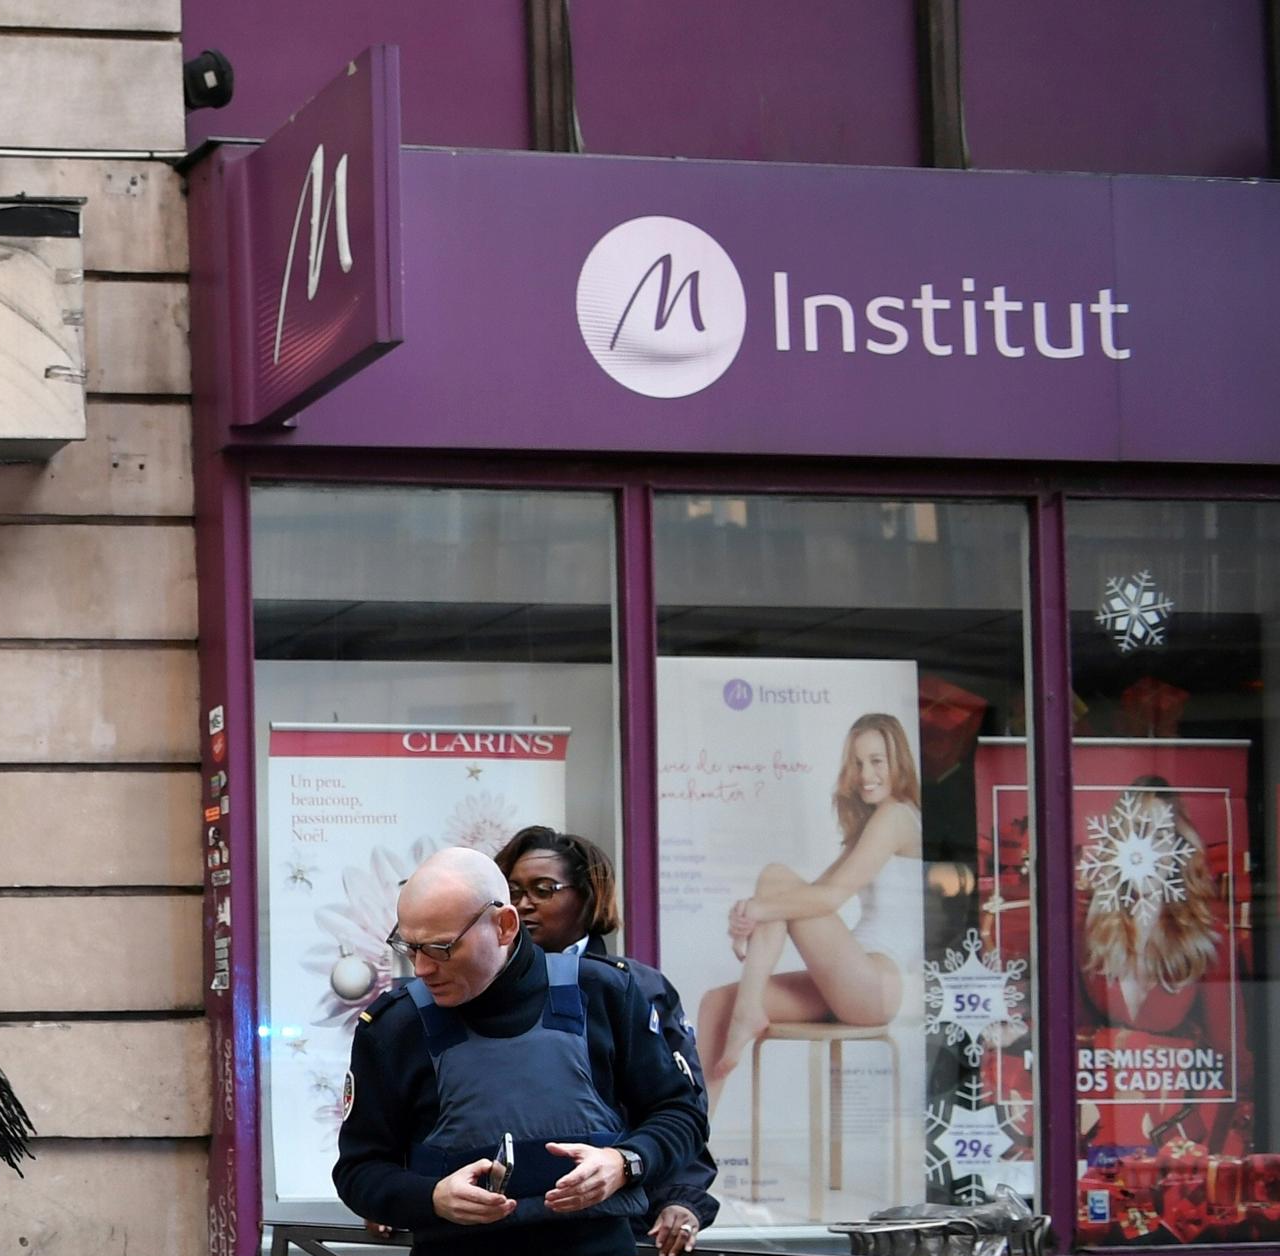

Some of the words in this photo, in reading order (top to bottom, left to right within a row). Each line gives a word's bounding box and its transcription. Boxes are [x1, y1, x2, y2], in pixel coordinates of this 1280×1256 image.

[773, 270, 1132, 361] Institut
[759, 684, 832, 705] Institut
[402, 731, 555, 755] CLARINS
[289, 774, 312, 789] Un
[953, 993, 992, 1013] 59€
[1112, 1048, 1225, 1069] MISSION:
[1076, 1070, 1109, 1092] OS
[1114, 1070, 1225, 1092] CADEAUX
[954, 1139, 993, 1158] 29€
